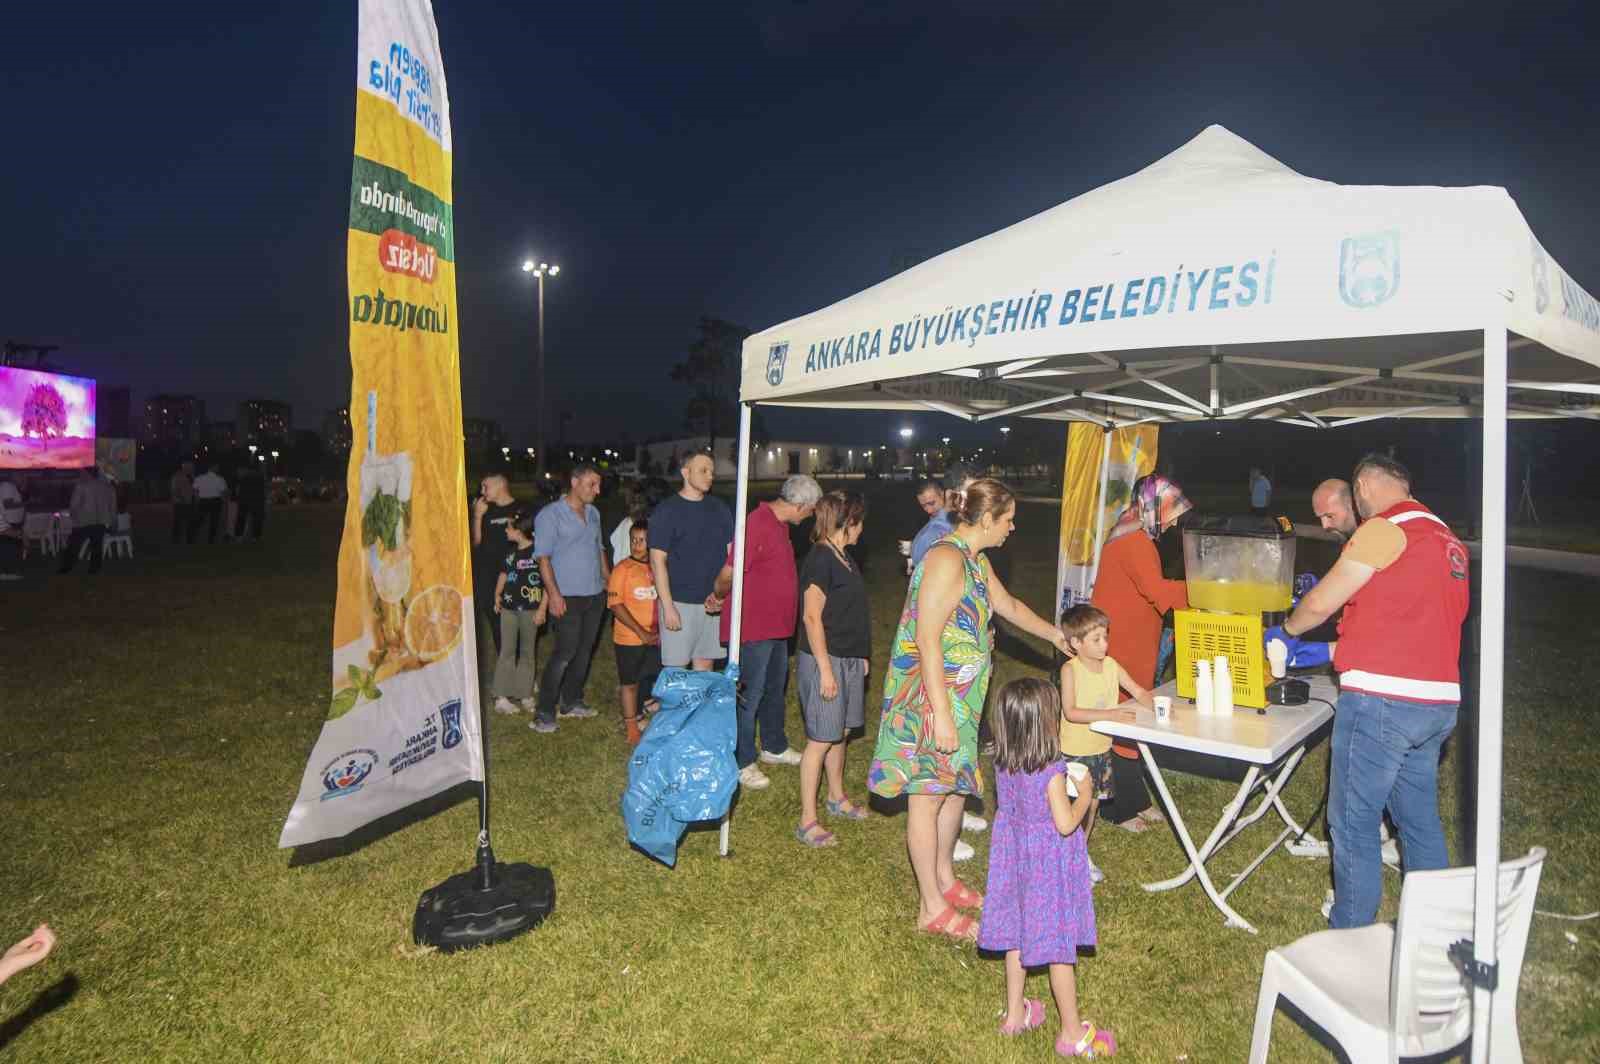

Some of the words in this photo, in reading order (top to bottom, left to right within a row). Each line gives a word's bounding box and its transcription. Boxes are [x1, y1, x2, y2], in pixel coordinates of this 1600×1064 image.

[804, 328, 881, 375] ANKARA
[888, 288, 1052, 349] BÜYÜKŞEHİR
[1058, 248, 1278, 326] BELEDİYESİ
